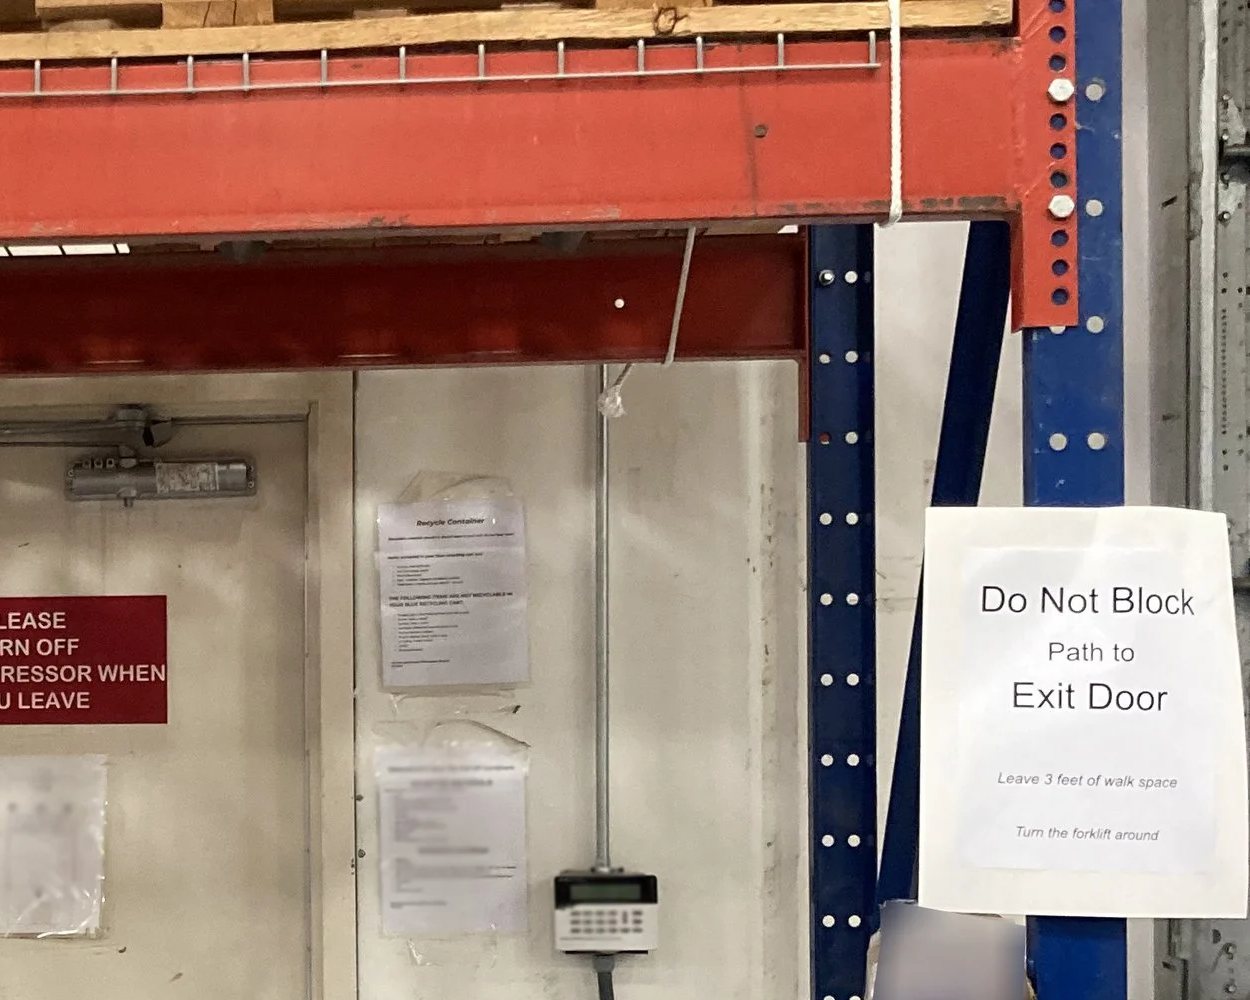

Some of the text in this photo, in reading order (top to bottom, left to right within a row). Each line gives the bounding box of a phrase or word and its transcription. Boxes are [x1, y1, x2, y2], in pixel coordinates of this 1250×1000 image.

[416, 518, 485, 528] Recycle Container
[981, 585, 1195, 615] Do Not Block
[36, 638, 80, 656] OFF
[1048, 642, 1135, 662] Path to
[97, 664, 166, 682] WHEN
[18, 692, 90, 710] LEAVE
[1013, 681, 1168, 711] Exit Door
[997, 772, 1178, 790] Leave 3 feet of walk space
[1016, 825, 1160, 842] Turn the forklift around
